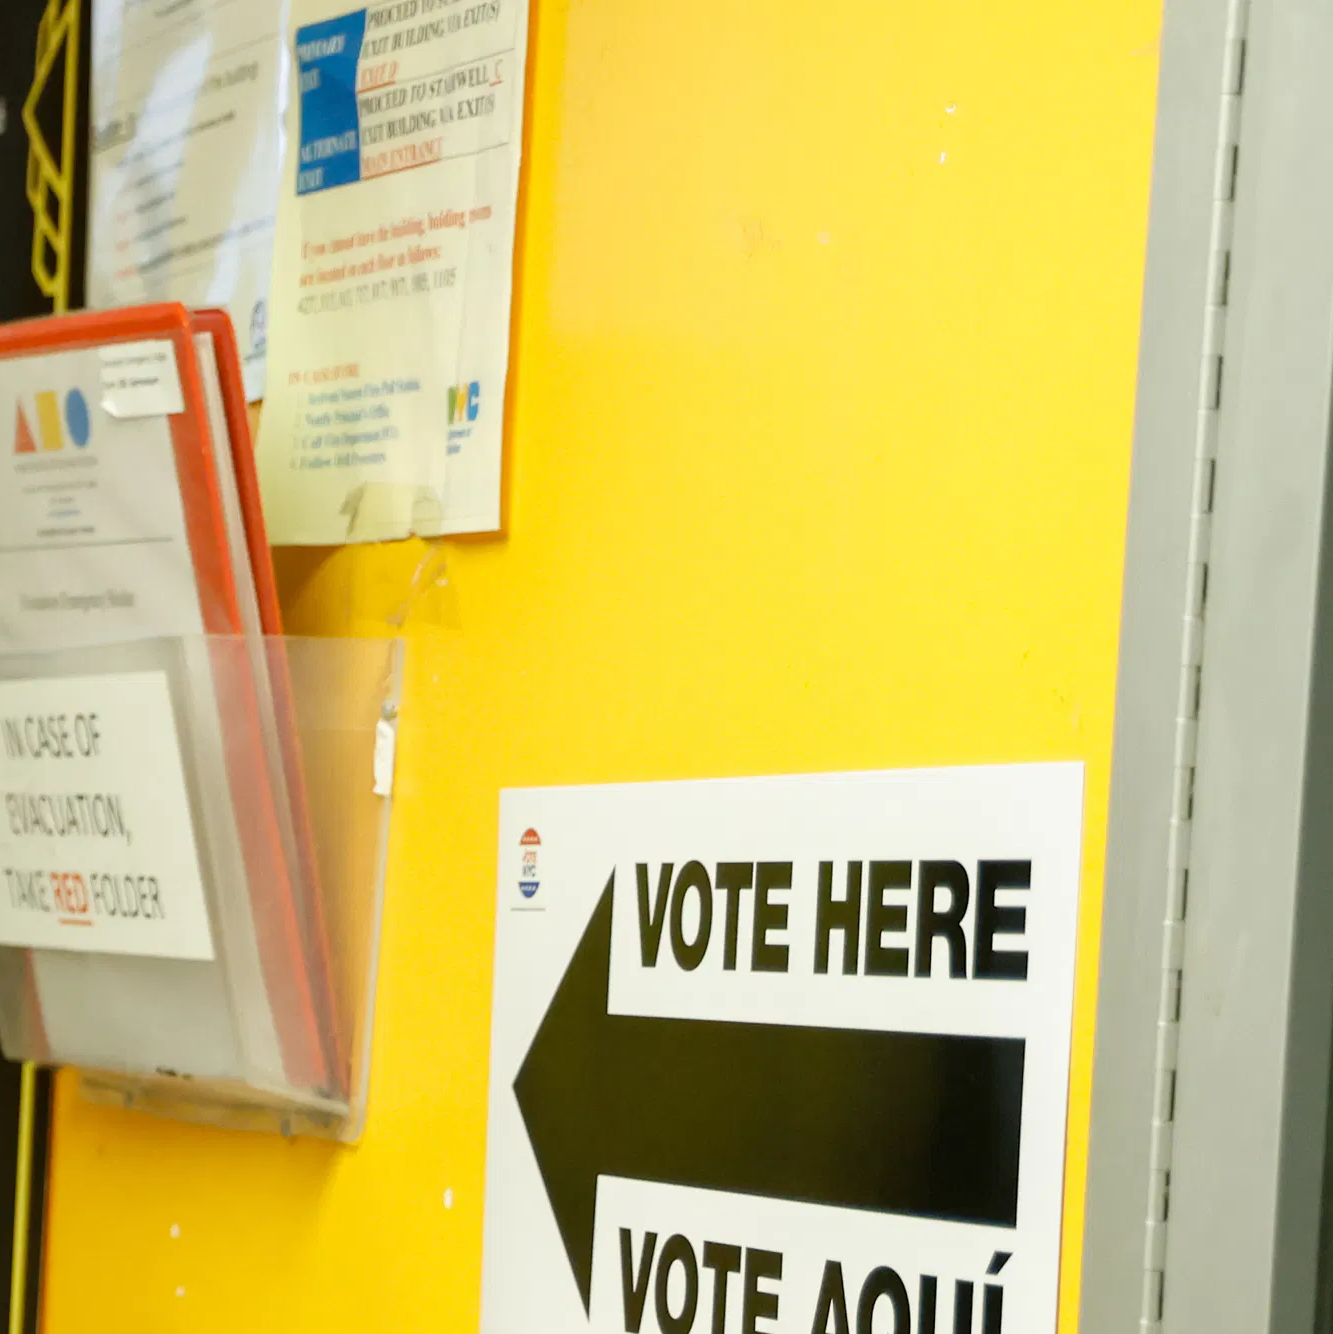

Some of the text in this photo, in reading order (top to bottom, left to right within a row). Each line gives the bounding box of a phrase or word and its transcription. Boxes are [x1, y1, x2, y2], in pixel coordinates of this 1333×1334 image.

[25, 713, 74, 758] CASE
[73, 712, 101, 757] OF
[89, 872, 166, 920] FOLDER
[637, 859, 1033, 982] VOTE HERE
